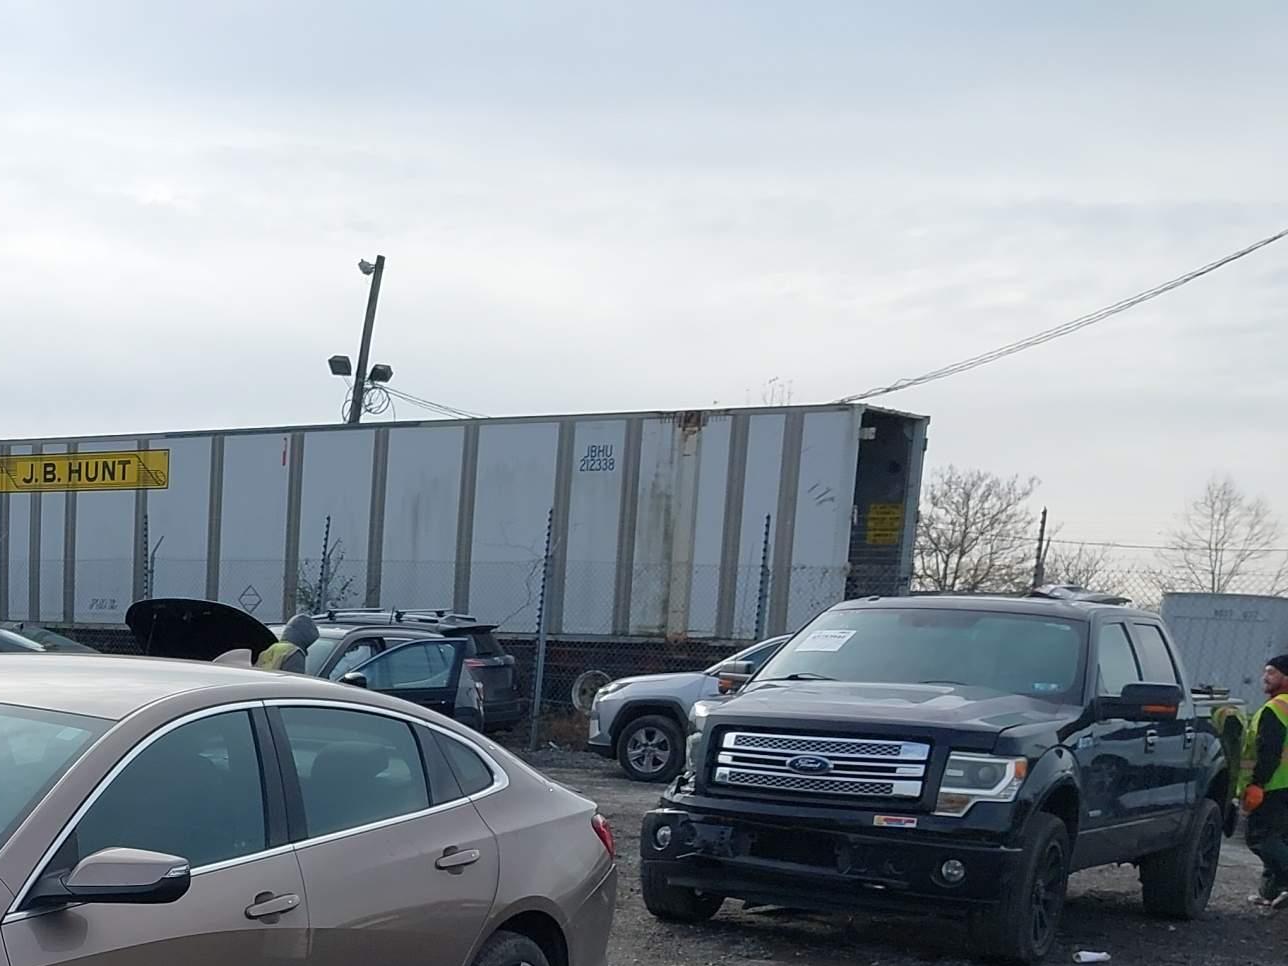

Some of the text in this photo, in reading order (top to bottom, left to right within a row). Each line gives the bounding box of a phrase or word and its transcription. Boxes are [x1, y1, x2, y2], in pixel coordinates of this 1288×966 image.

[584, 444, 613, 458] JBHU
[68, 460, 131, 483] HUNT
[579, 458, 615, 472] 212338
